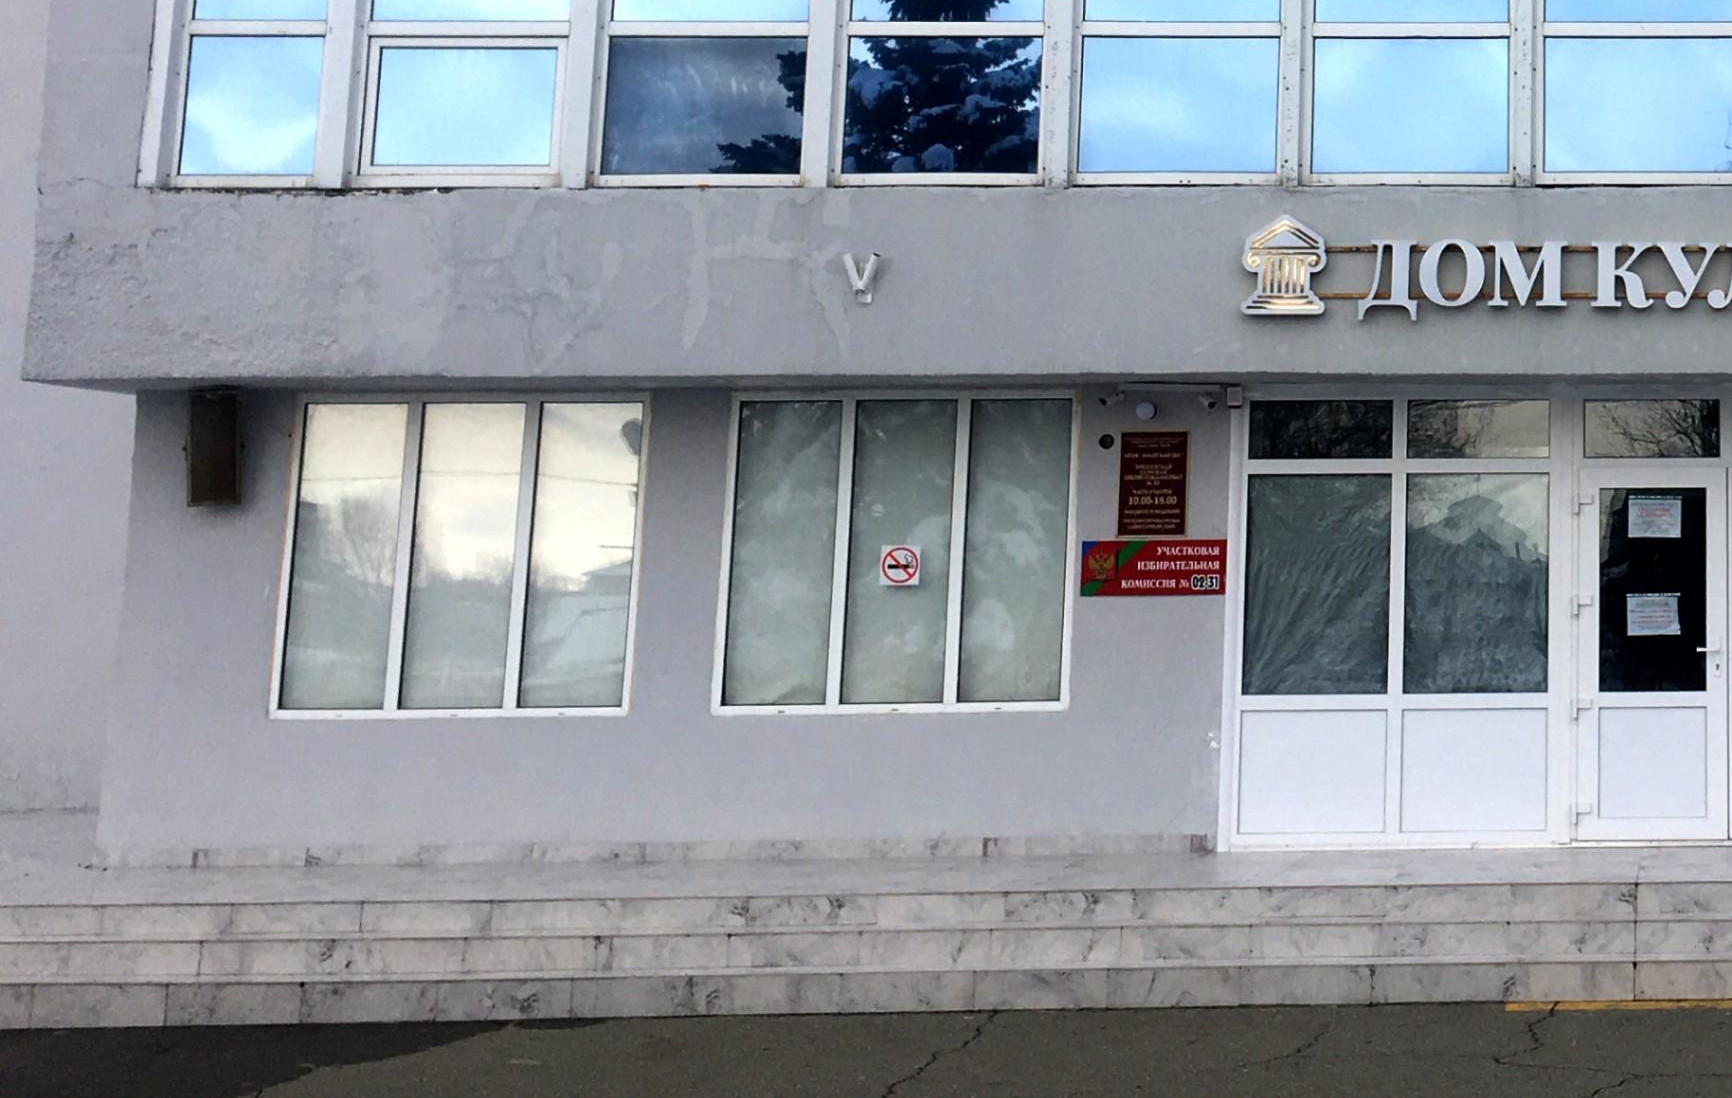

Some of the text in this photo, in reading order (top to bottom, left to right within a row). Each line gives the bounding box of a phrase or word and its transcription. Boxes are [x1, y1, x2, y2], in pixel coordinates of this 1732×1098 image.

[1357, 239, 1568, 321] ДОМ
[1156, 546, 1220, 556] УЧАСТКОВАЯ
[1137, 561, 1220, 571] ИЗБИРАТЕЛЬНАЯ
[1121, 579, 1176, 589] КОМИССИЯ
